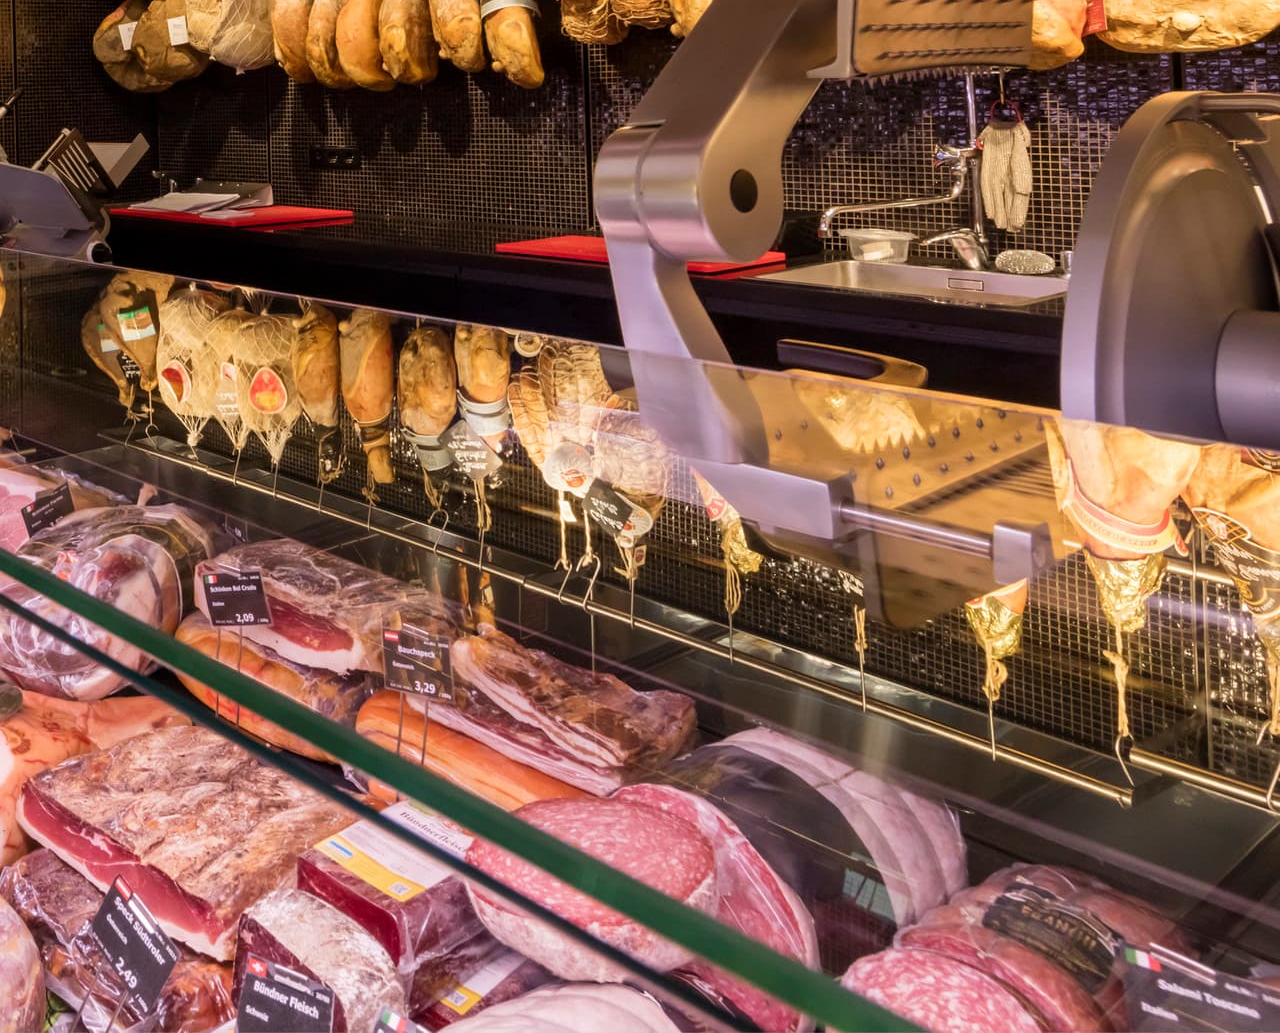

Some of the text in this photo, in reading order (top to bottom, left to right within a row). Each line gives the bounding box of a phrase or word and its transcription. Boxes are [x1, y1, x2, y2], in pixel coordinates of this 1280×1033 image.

[235, 613, 255, 624] 2,09
[397, 645, 436, 659] Bauchspeck
[414, 680, 436, 694] 3,29
[114, 896, 135, 925] Speck
[132, 921, 166, 966] Südtiroler
[115, 957, 138, 989] 2,49
[253, 979, 289, 1005] Bündner
[288, 994, 320, 1020] Fleisch
[1157, 978, 1203, 1002] Salami
